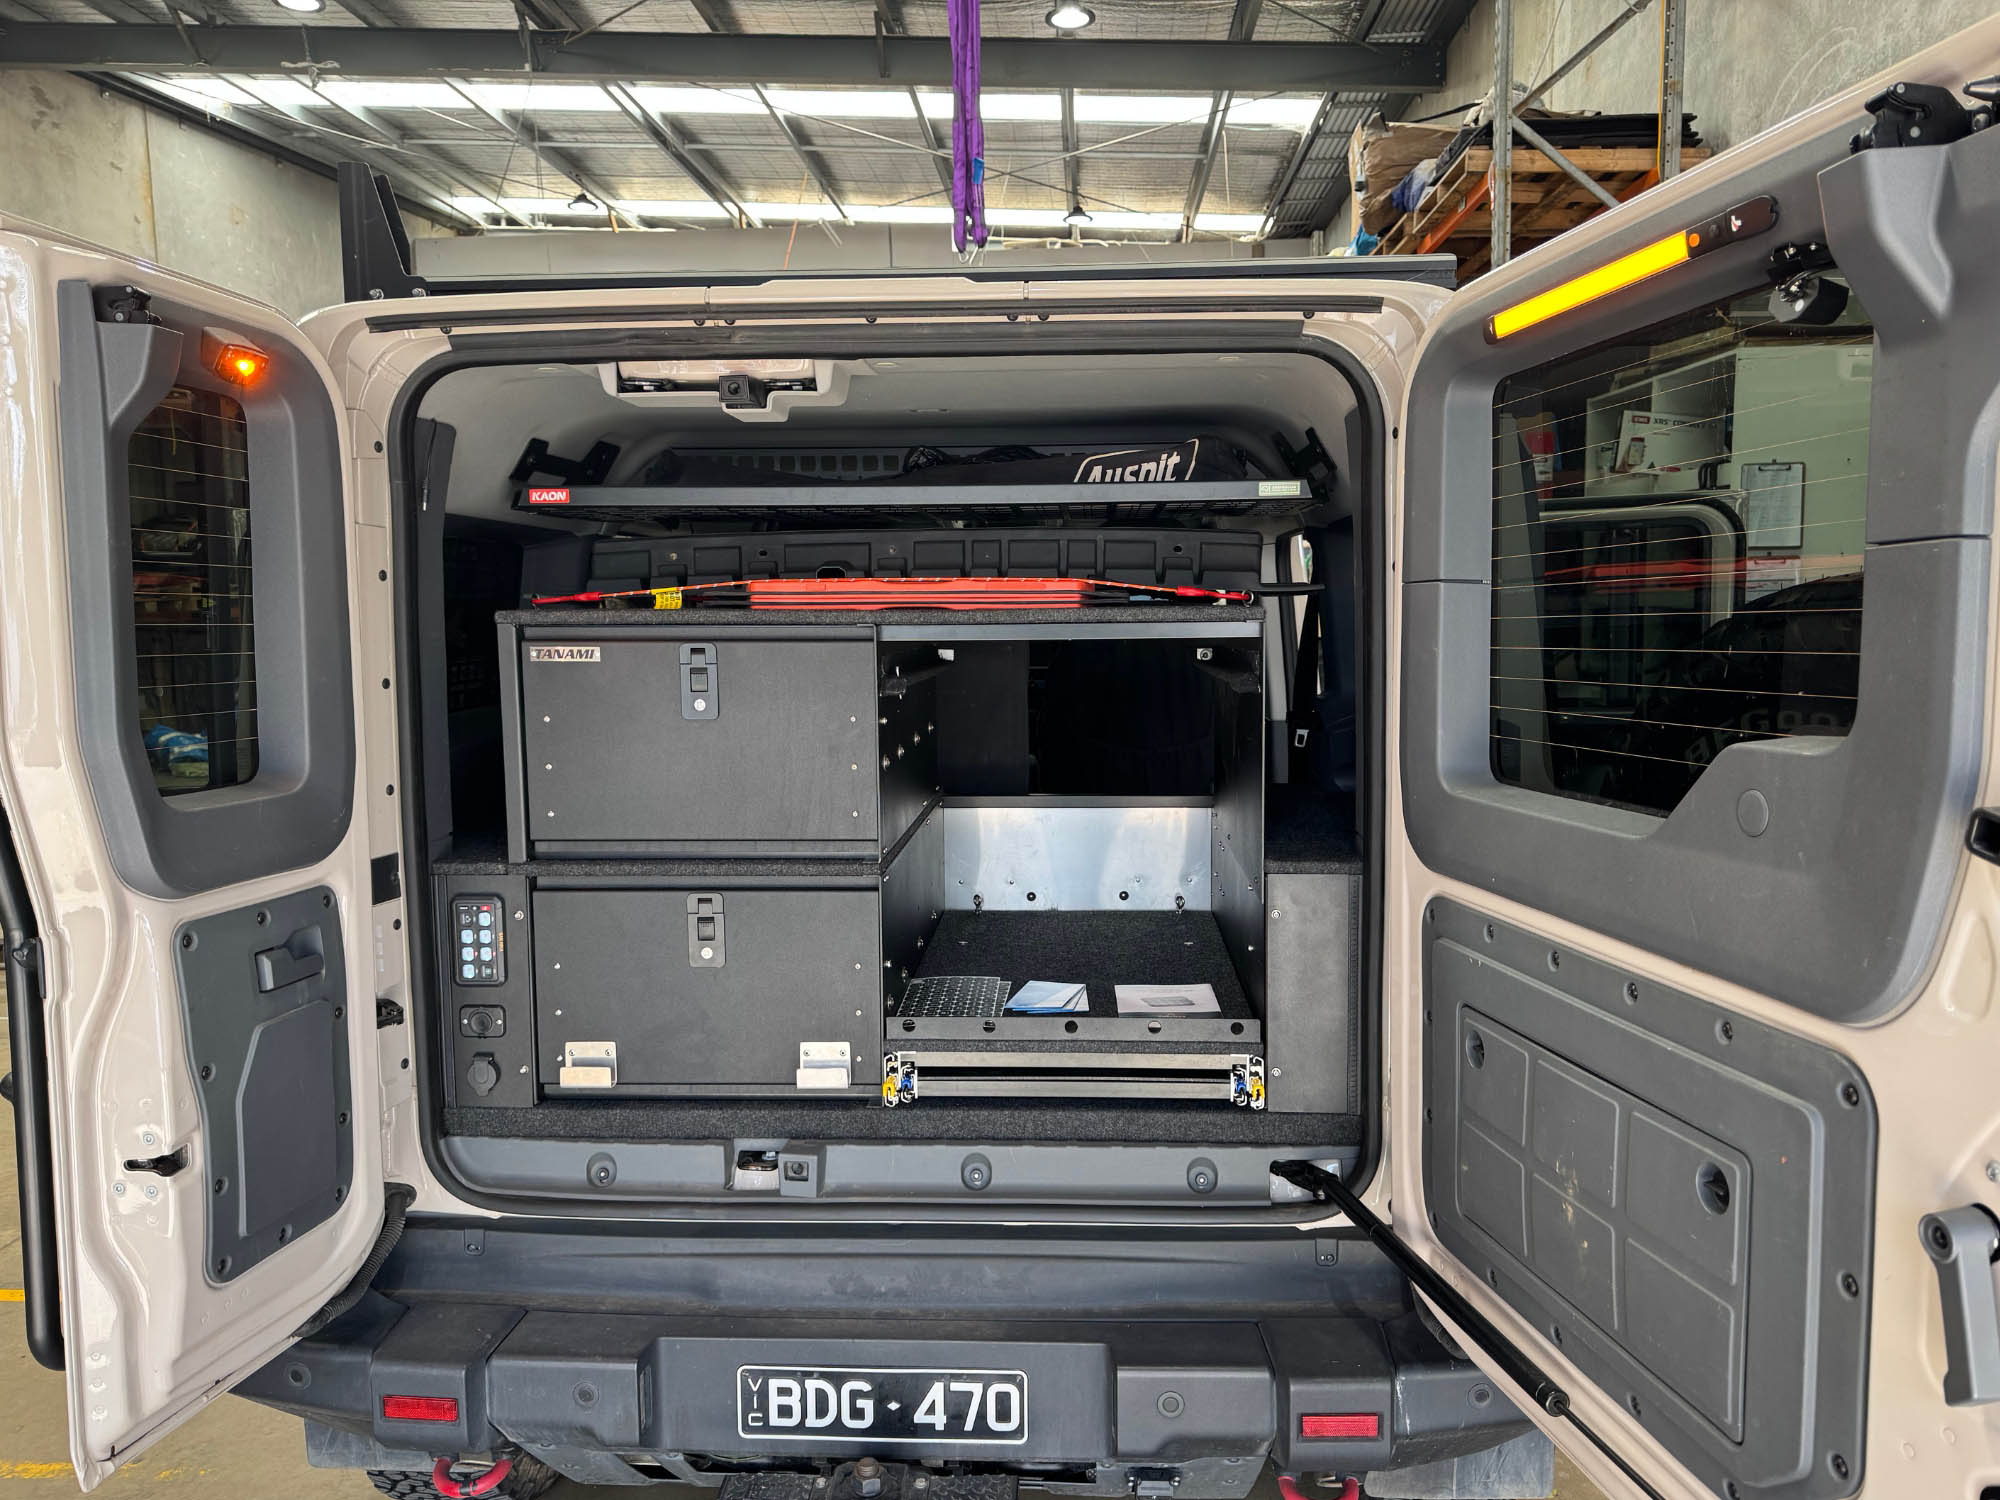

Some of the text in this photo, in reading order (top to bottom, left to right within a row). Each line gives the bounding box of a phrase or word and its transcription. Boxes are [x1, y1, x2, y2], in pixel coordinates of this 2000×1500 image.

[532, 491, 567, 501] KAON
[535, 648, 595, 660] TANAMI
[748, 1378, 763, 1426] VIC
[768, 1378, 1021, 1432] BDG 470
